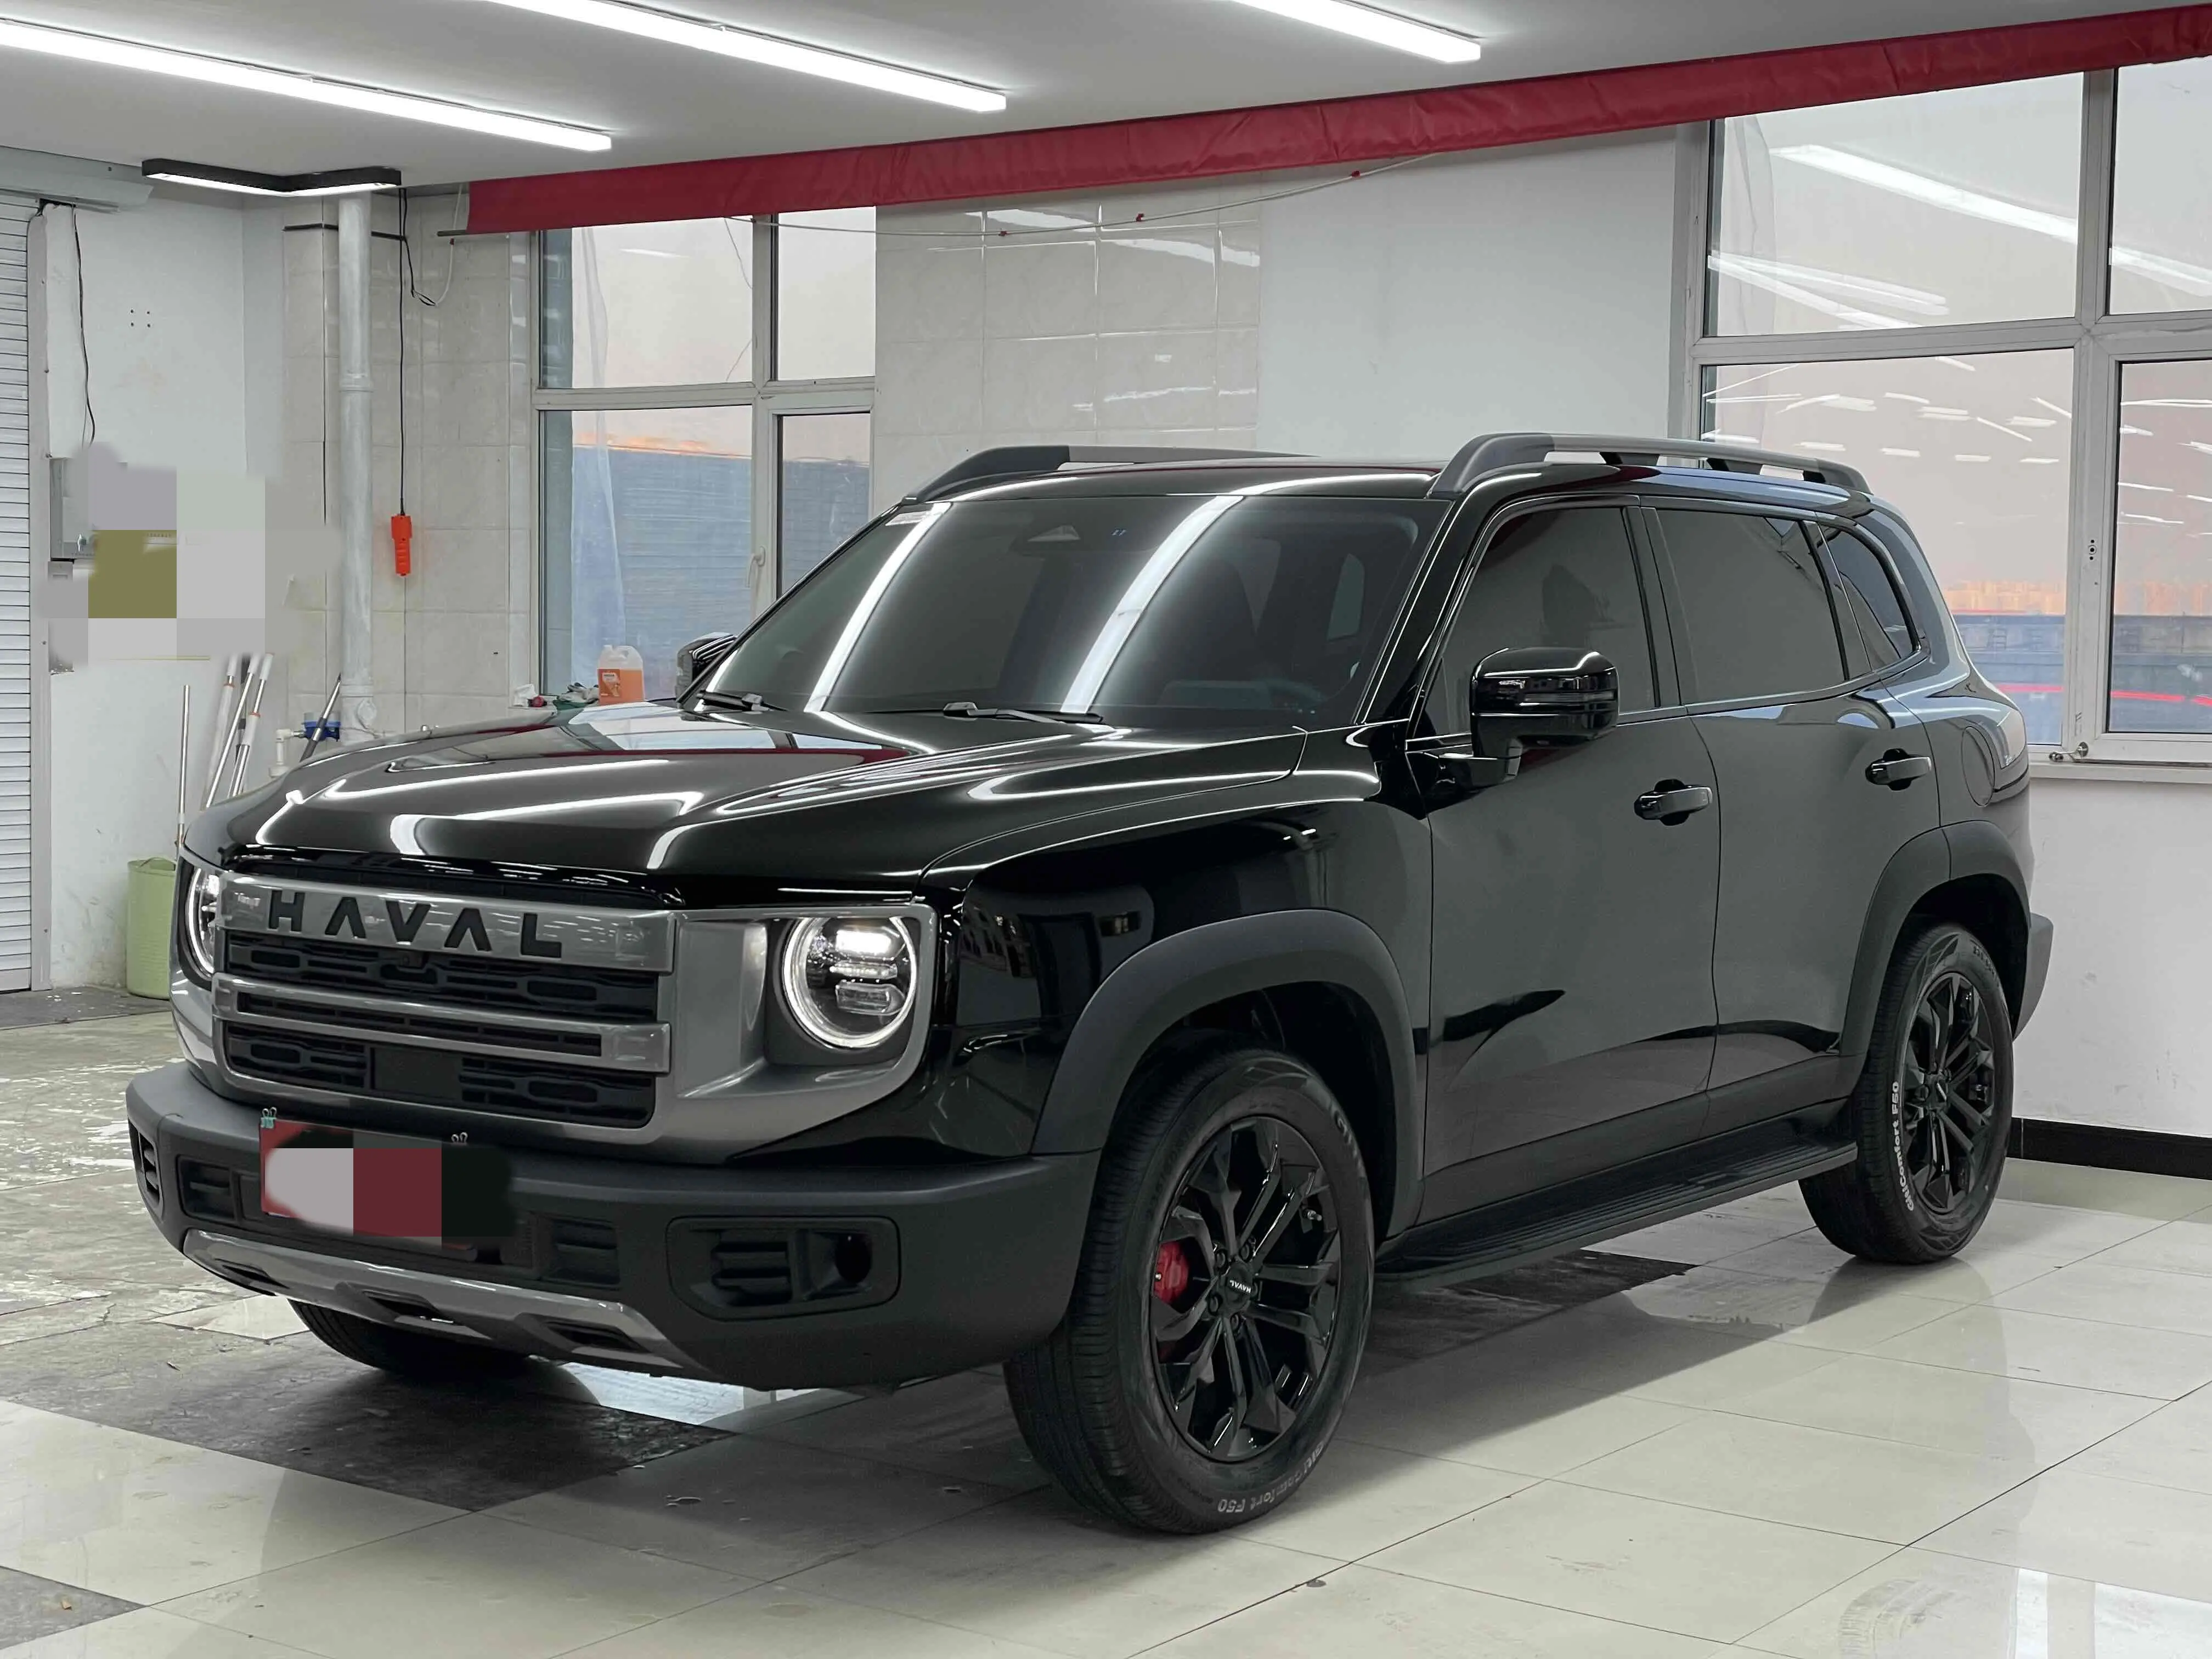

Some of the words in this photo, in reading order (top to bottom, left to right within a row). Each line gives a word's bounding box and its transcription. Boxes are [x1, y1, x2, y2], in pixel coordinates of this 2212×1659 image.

[268, 890, 562, 958] HAVAL
[1229, 1280, 1251, 1294] HAVAL
[1217, 1498, 1246, 1513] F50
